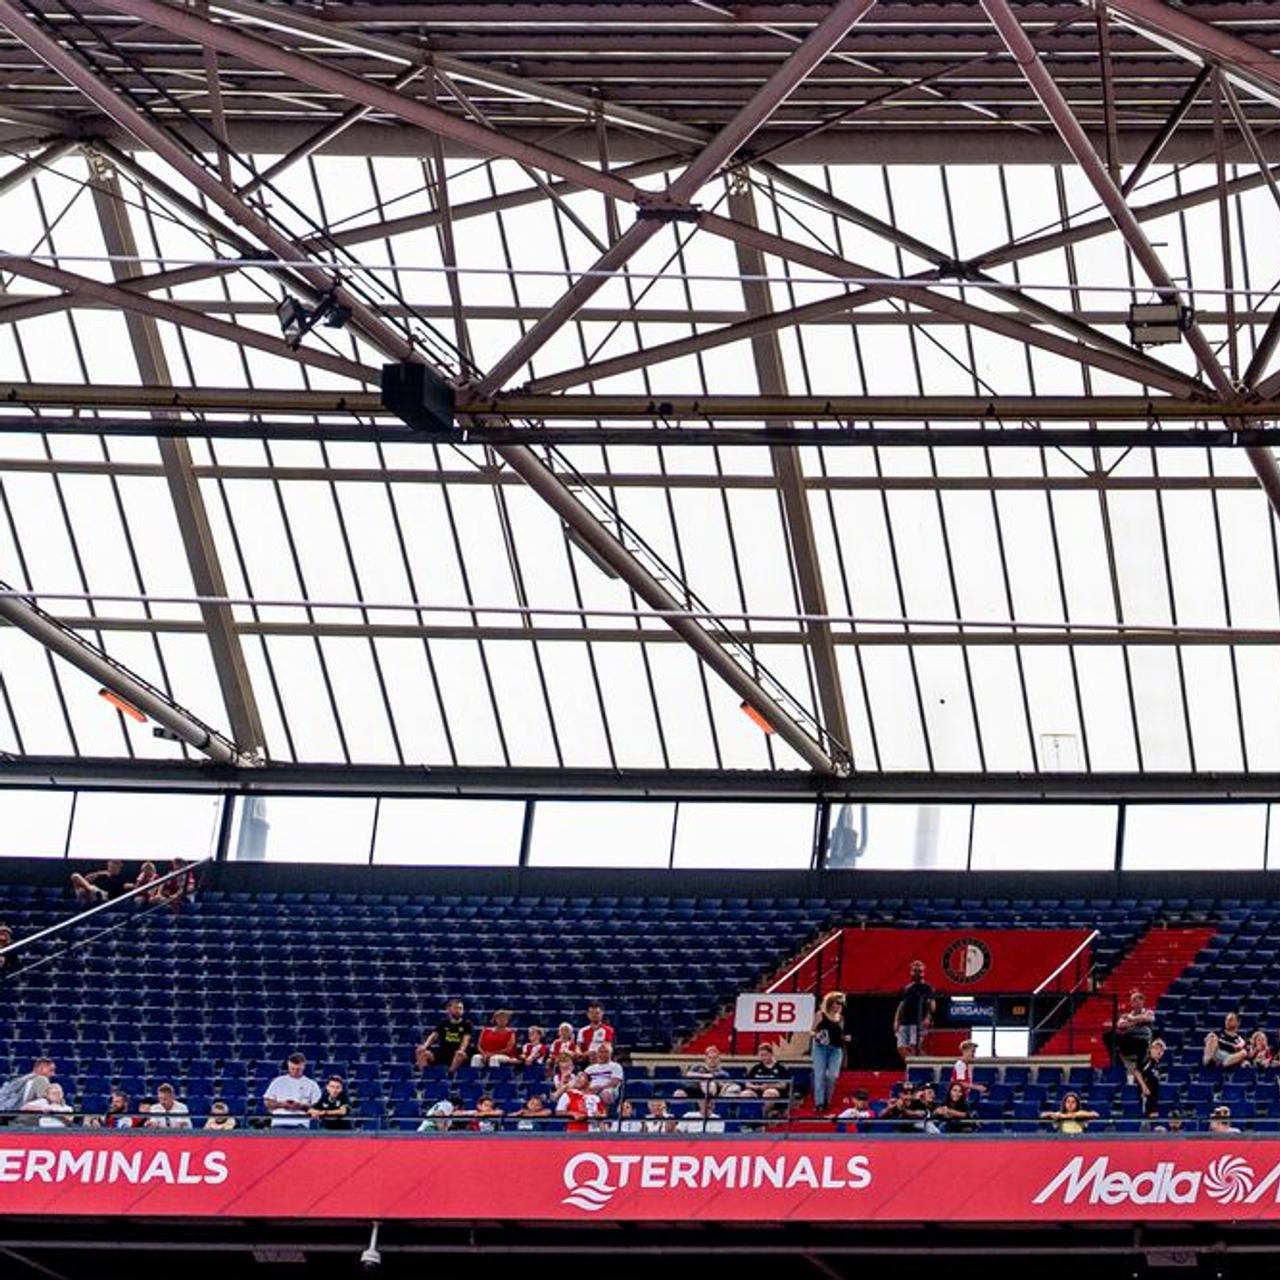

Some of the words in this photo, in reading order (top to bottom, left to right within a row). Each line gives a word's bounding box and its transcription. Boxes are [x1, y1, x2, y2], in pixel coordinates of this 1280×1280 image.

[754, 1001, 796, 1024] BB
[562, 1152, 872, 1209] QTERMINALS
[1032, 1156, 1203, 1205] Media
